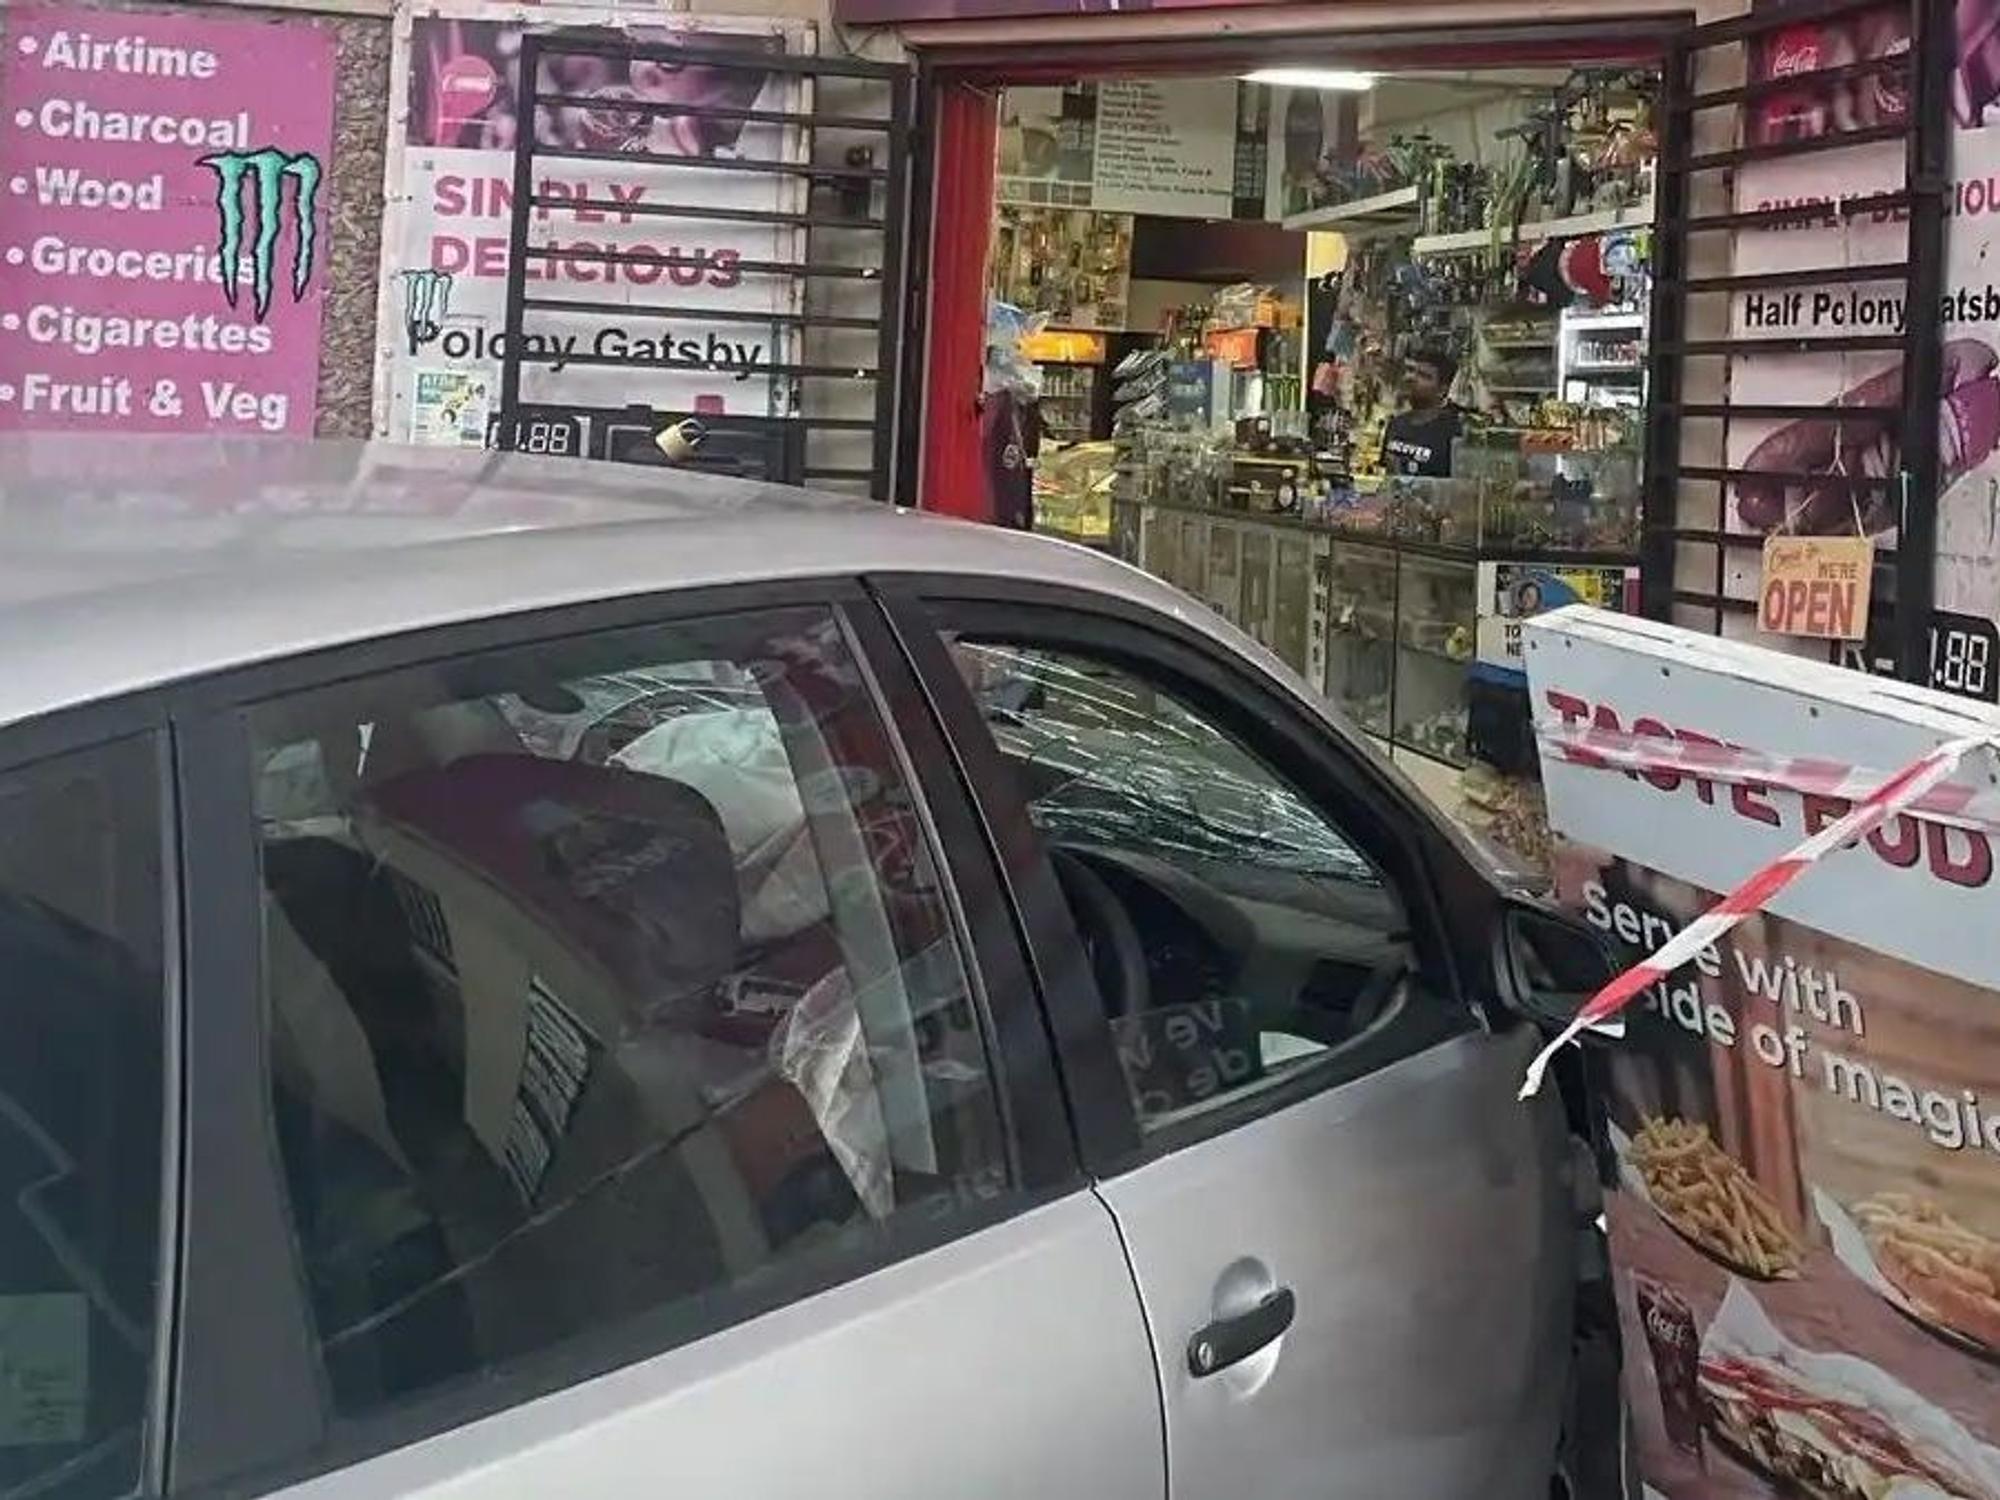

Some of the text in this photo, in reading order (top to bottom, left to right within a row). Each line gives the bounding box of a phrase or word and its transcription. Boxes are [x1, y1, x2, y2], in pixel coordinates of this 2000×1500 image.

[42, 31, 219, 78] Airtime
[40, 99, 249, 148] Charcoal
[36, 167, 164, 211] Wood
[32, 236, 256, 284] Groceries
[27, 305, 273, 355] Cigarettes
[1745, 285, 2000, 332] Half Polony atsb
[593, 327, 763, 381] Gatsby
[23, 374, 289, 431] Fruit & Veg
[1764, 579, 1856, 636] OPEN
[1734, 949, 1866, 1036] with
[1751, 1024, 1807, 1078] of
[1823, 1051, 2000, 1151] magic
